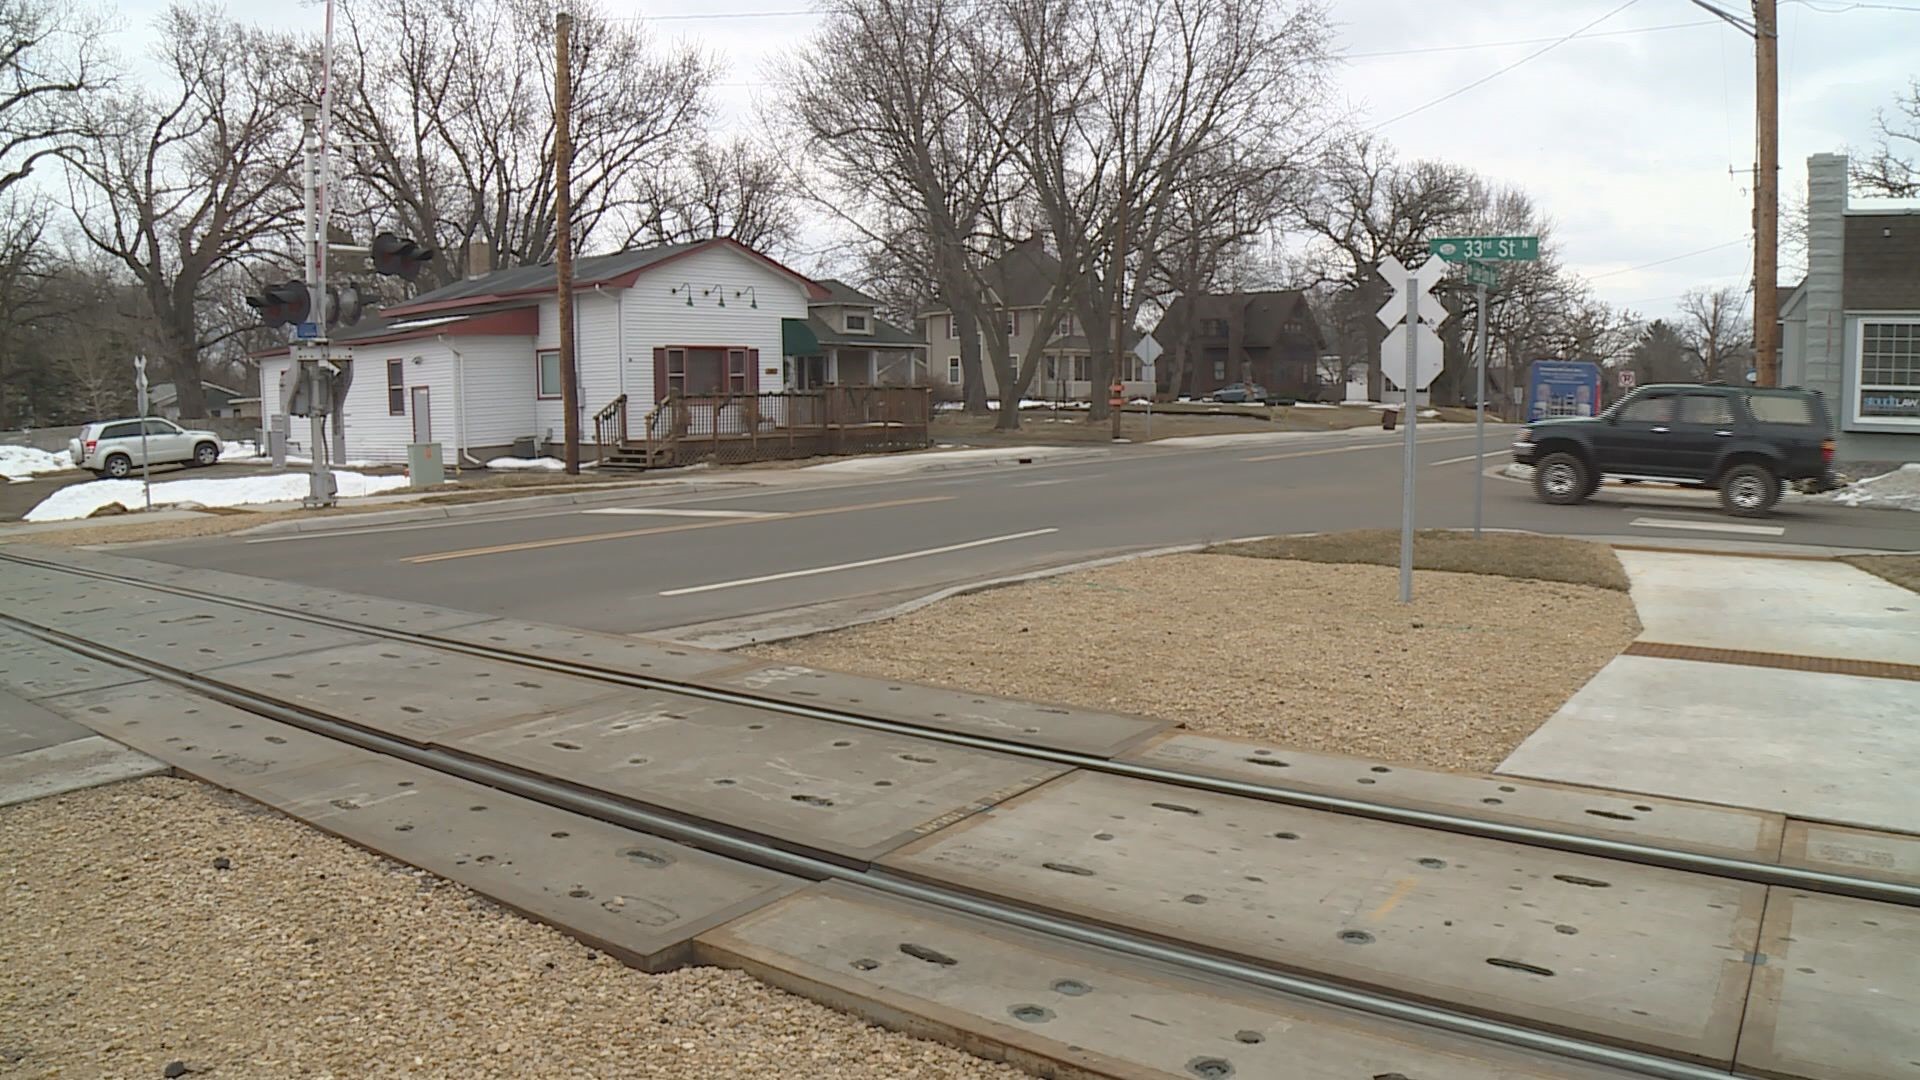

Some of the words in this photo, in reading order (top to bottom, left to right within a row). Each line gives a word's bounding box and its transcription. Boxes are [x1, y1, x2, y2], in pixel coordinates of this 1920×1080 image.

[1464, 240, 1492, 257] 33rd
[1498, 240, 1515, 257] St
[1522, 240, 1529, 248] N
